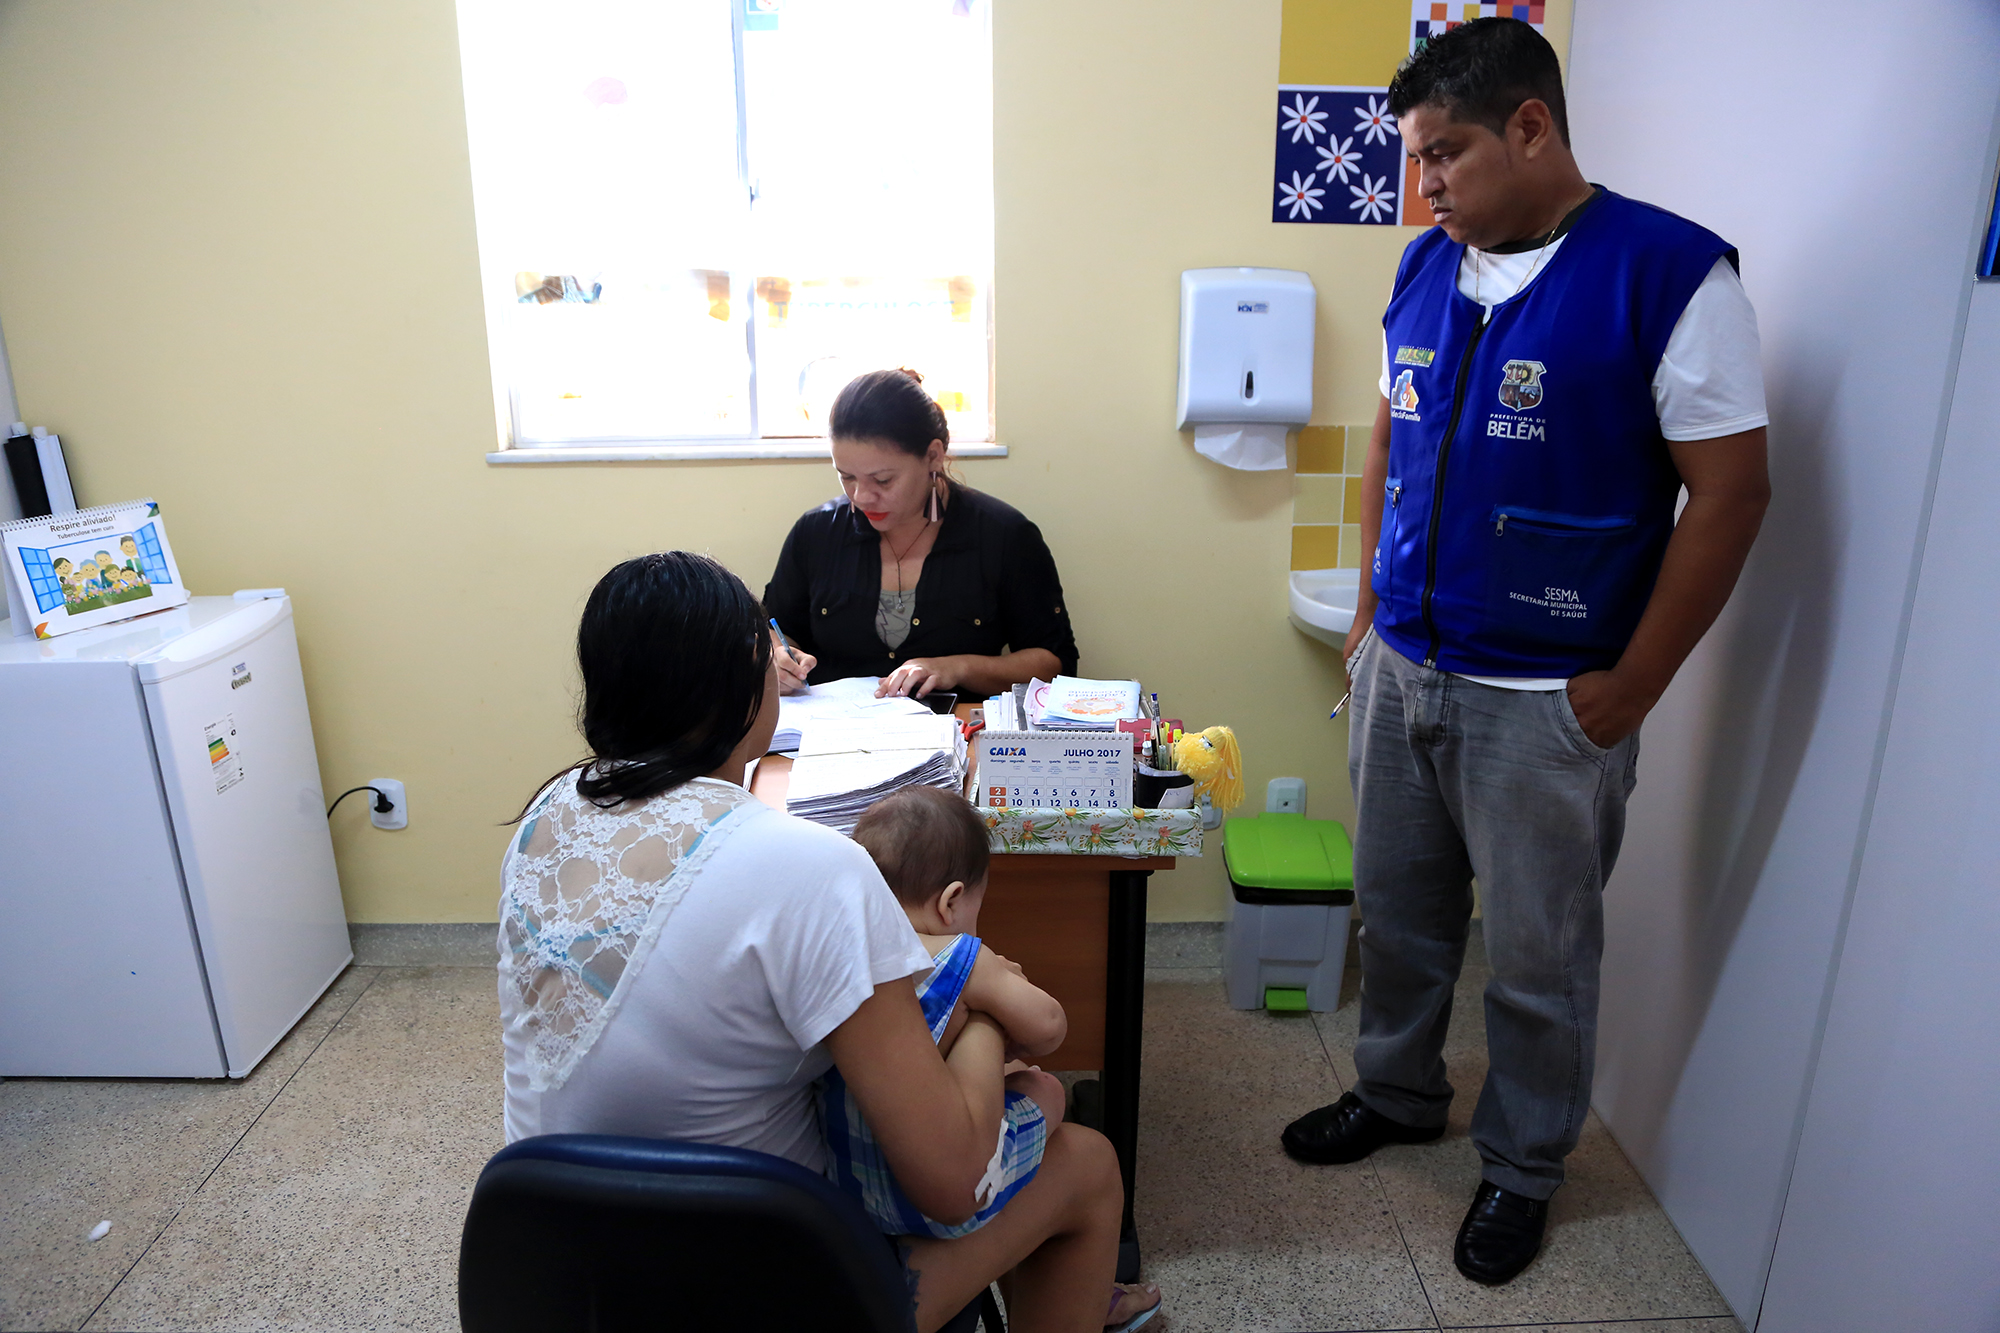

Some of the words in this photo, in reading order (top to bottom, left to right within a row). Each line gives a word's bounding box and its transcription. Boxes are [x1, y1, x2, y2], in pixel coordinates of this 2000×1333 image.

[1395, 347, 1434, 364] BRASIL
[1489, 413, 1533, 422] PREFEITURA
[1487, 420, 1545, 442] BELÉM
[50, 521, 80, 532] Respire
[82, 514, 116, 526] aliviado!
[58, 530, 90, 540] Tuberculose
[1544, 587, 1579, 602] SESMA
[1509, 592, 1548, 606] SECRETARIA
[1550, 601, 1587, 610] MUNICIPAL
[1561, 610, 1587, 618] SAÚDE
[989, 747, 1027, 756] CAIXA
[1063, 749, 1094, 757] JULHO
[1097, 749, 1121, 757] 2017
[1014, 788, 1020, 796] 3
[1033, 788, 1039, 796] 4
[1052, 788, 1058, 796] 5
[1090, 789, 1096, 797] 7
[1109, 789, 1115, 797] 8
[995, 798, 1001, 806] 9
[1050, 799, 1061, 807] 12
[1107, 800, 1118, 808] 15
